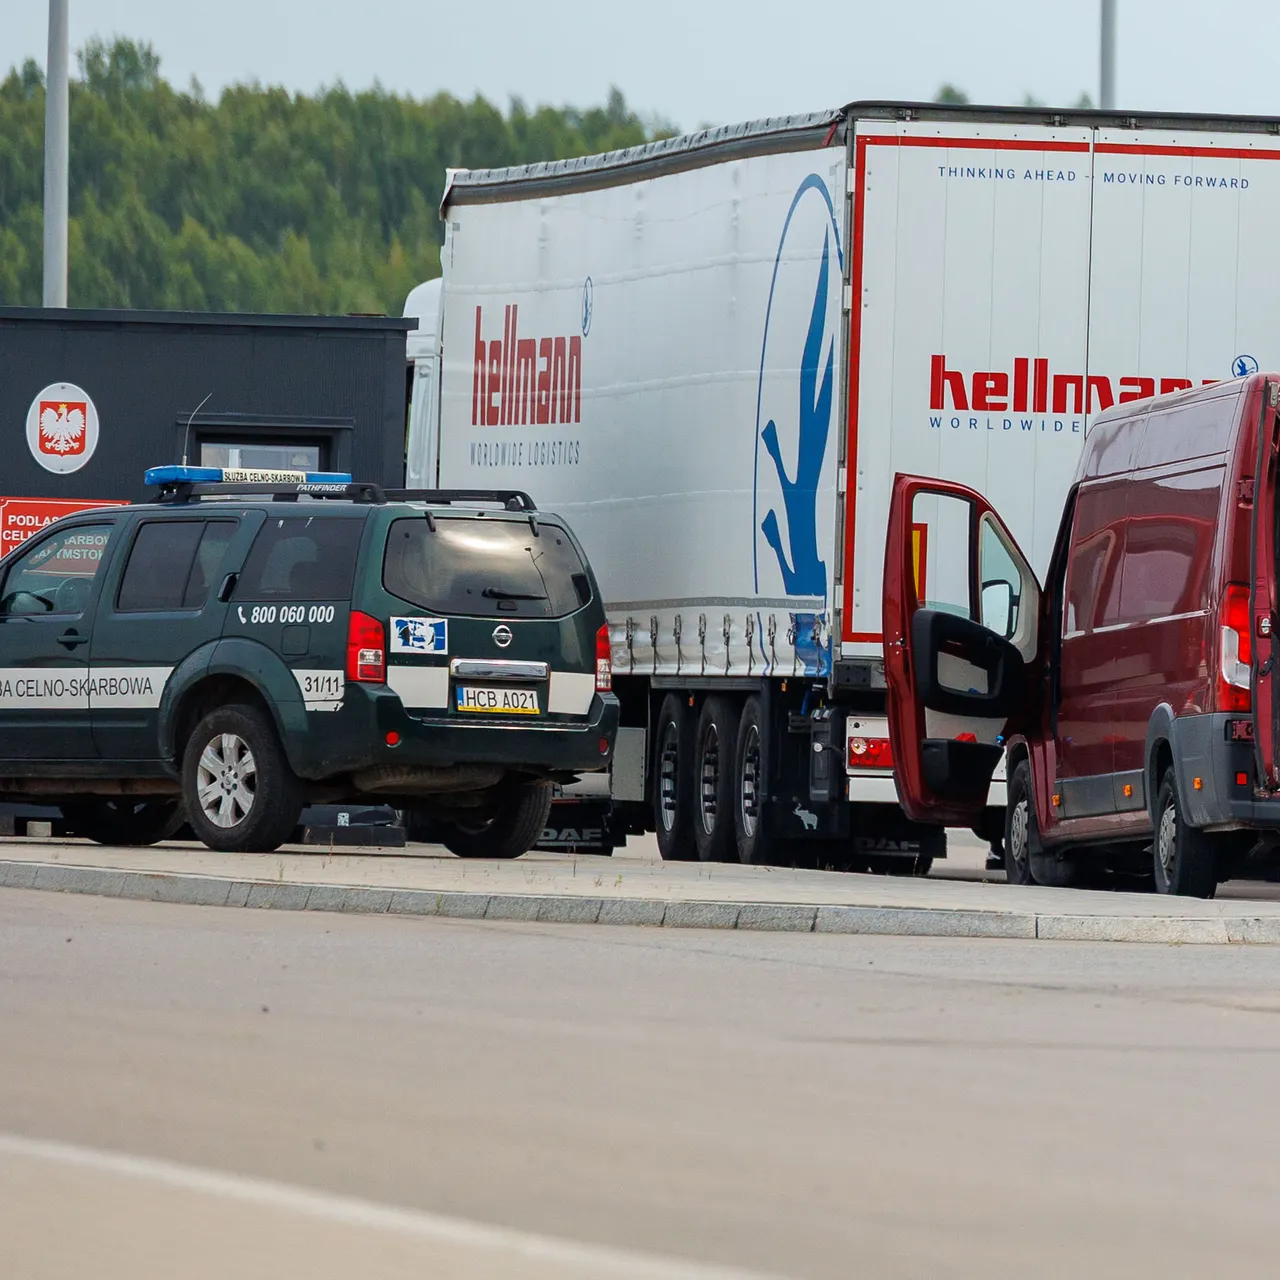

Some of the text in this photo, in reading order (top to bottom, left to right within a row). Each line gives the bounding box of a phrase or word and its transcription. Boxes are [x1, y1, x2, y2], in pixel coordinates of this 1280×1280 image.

[938, 166, 1016, 180] THINKING
[1023, 169, 1077, 182] AHEAD
[1103, 172, 1166, 185] MOVING
[1174, 175, 1250, 189] FORWARD
[471, 304, 581, 426] hellmann
[929, 417, 1081, 433] WORLDWIDE
[470, 440, 580, 467] WORLDWIDE LOGISTICS
[296, 483, 348, 492] PATHFINDER
[251, 605, 335, 624] 800 060 000
[15, 676, 154, 698] CELNO-SKARBOWA
[304, 676, 340, 693] 31/11
[465, 689, 536, 710] HCB A021
[538, 828, 602, 841] DAF
